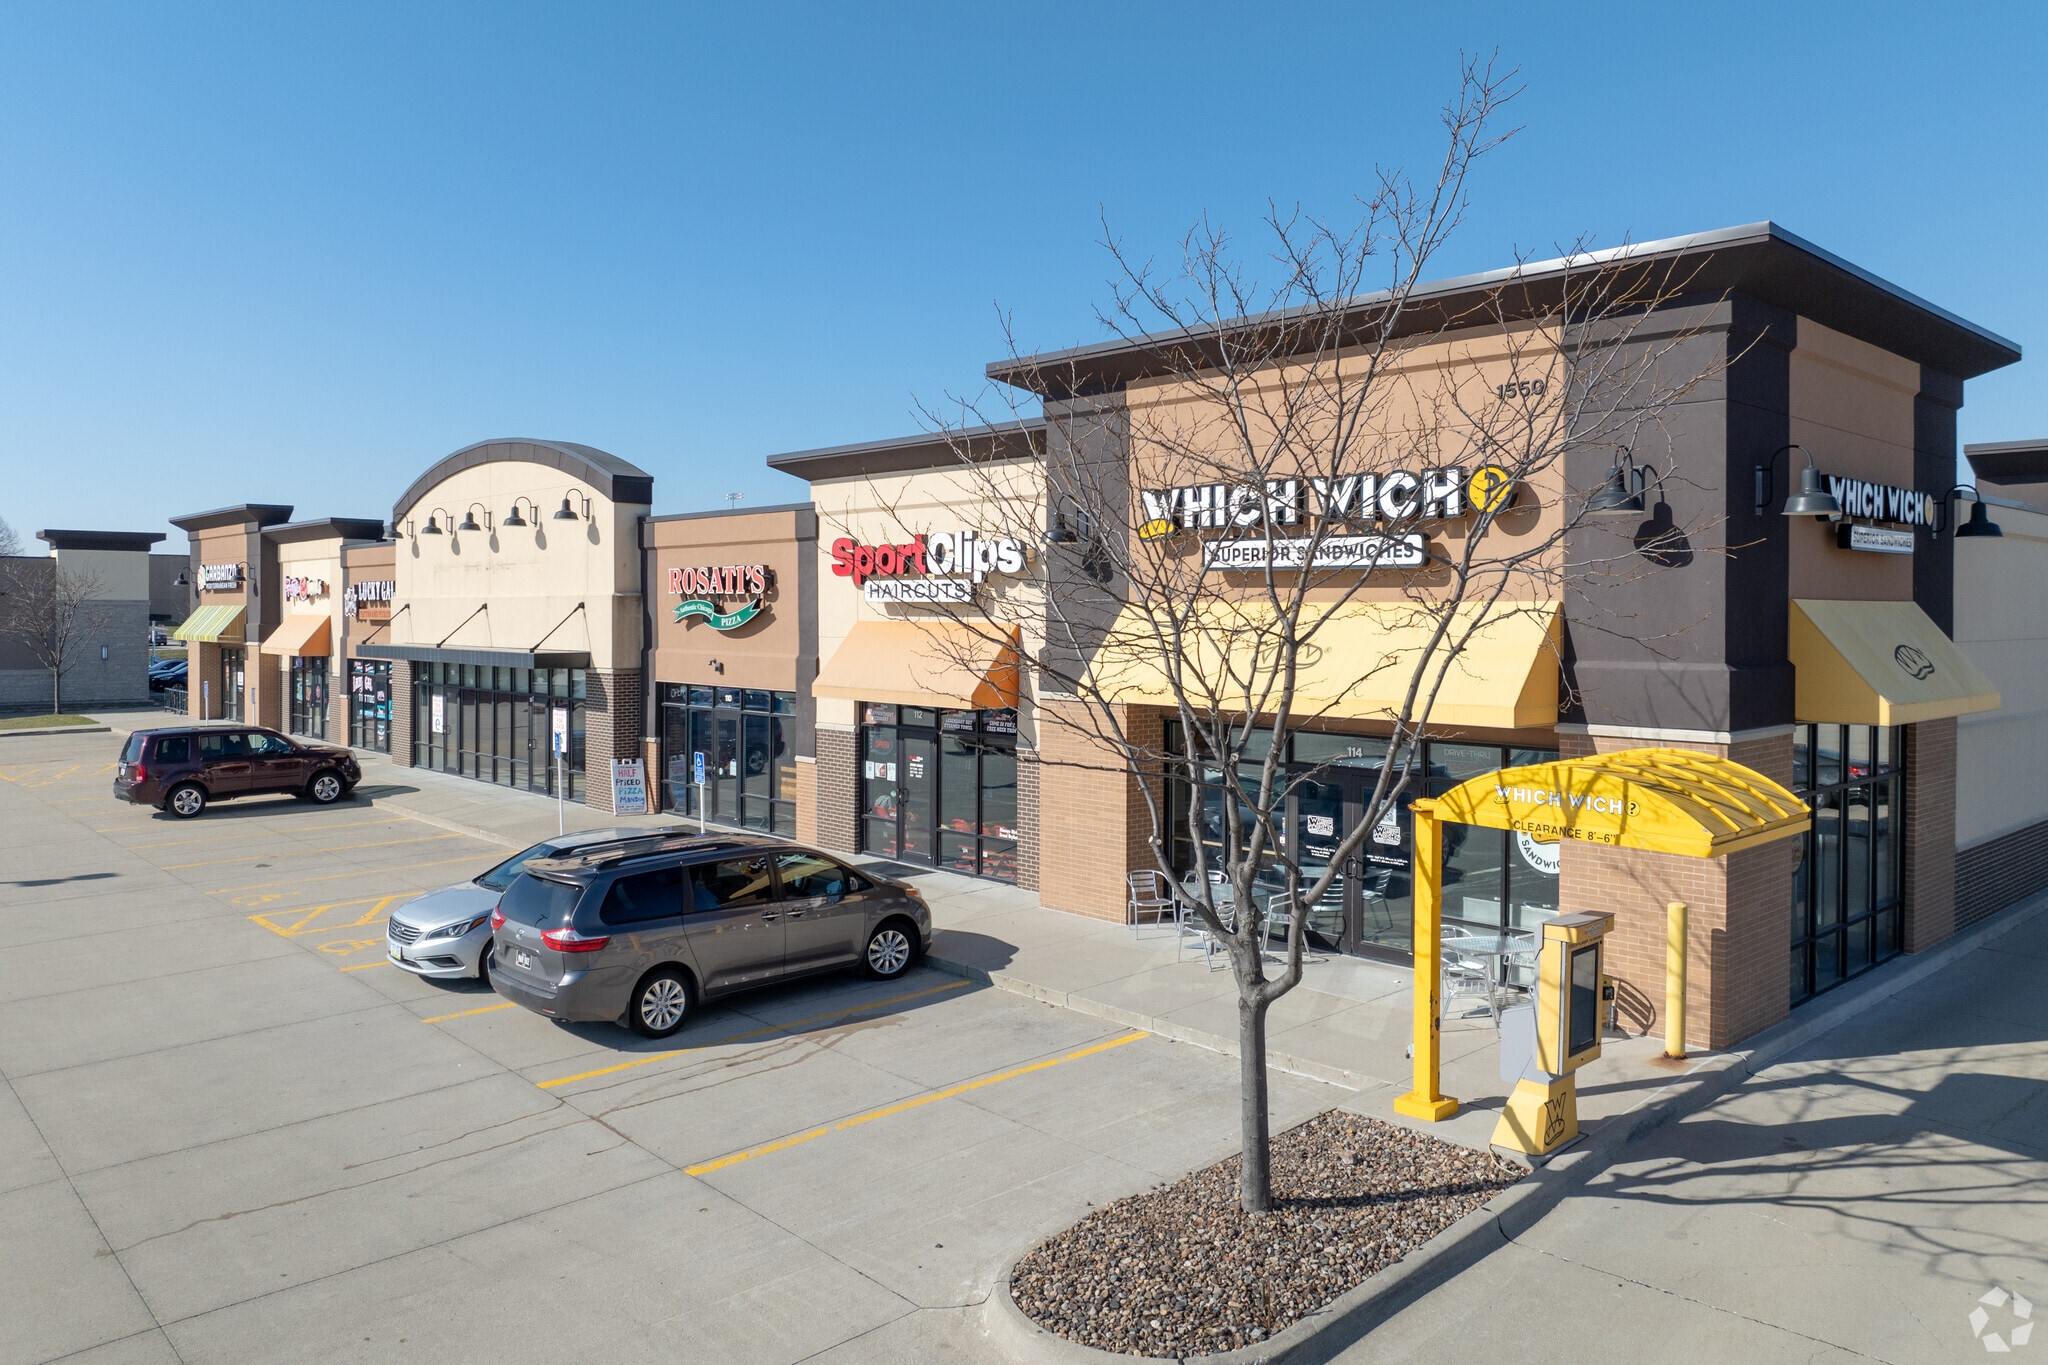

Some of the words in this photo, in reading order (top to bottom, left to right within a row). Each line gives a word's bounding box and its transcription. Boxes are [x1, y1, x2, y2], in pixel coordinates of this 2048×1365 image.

[1496, 379, 1545, 399] 1550
[1141, 479, 1299, 530] WHICH
[1311, 465, 1463, 523] WICH
[1829, 475, 1884, 520] WHICH
[1887, 486, 1924, 526] WICH
[1211, 546, 1291, 562] SUPERIOR
[668, 565, 766, 595] ROSATI'S
[358, 581, 381, 601] LUCKY
[869, 583, 967, 599] HAIRCUTS
[721, 615, 742, 627] PIZZA
[914, 710, 923, 719] 112
[1347, 746, 1363, 758] 114
[1443, 748, 1491, 760] DRIVE-THRU
[617, 768, 637, 778] HALF
[1494, 784, 1562, 807] WHICH
[1568, 793, 1623, 815] WICH
[1513, 820, 1582, 840] CLEARANCE
